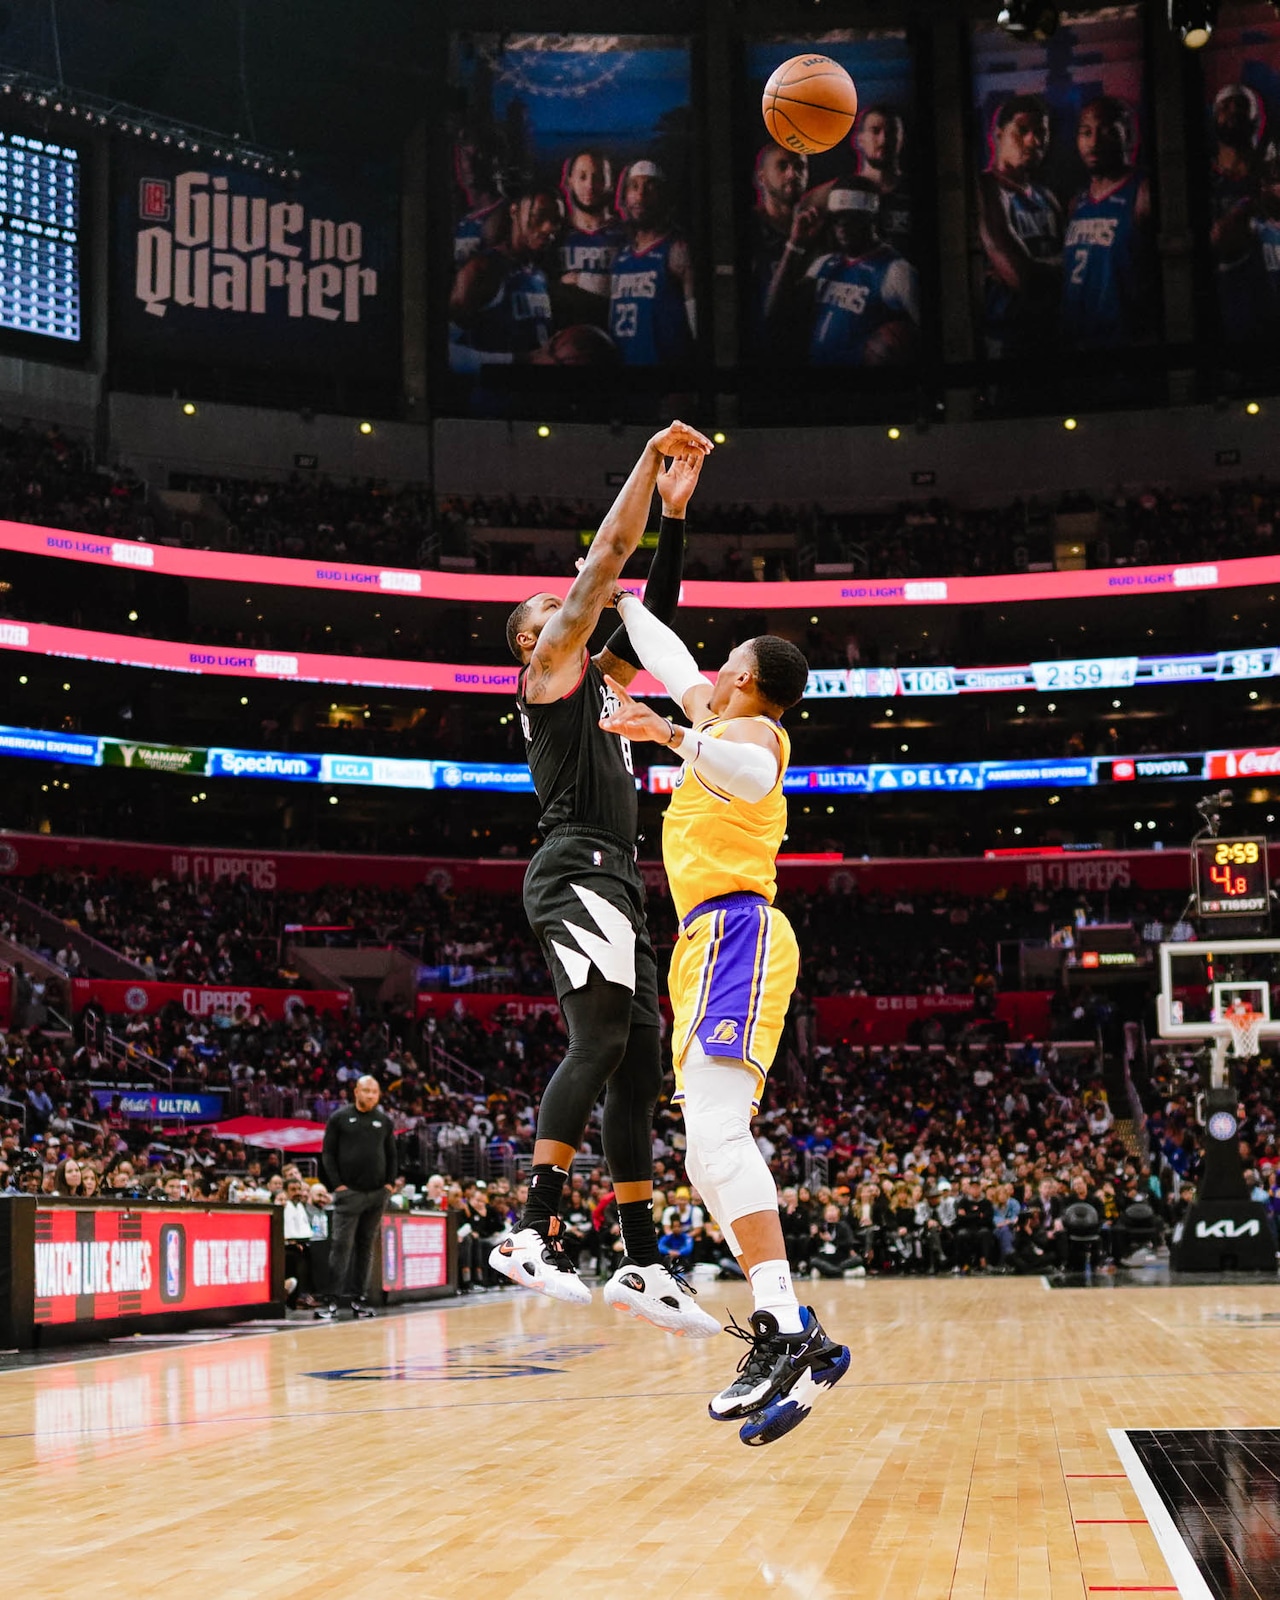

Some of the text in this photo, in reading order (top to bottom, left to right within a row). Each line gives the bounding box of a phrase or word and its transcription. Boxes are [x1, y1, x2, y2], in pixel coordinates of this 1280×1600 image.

[175, 171, 362, 262] Give no
[136, 226, 377, 323] Quarter
[1071, 249, 1088, 284] 2
[615, 303, 638, 337] 23
[47, 537, 73, 550] BUD
[76, 541, 111, 555] LIGHT
[316, 570, 342, 580] BUD
[344, 572, 380, 584] LIGHT
[1108, 576, 1135, 586] BUD
[1137, 571, 1174, 585] LIGHT
[841, 588, 867, 597] BUD
[869, 586, 904, 597] LIGHT
[190, 653, 216, 665] BUD
[218, 656, 254, 668] LIGHT
[455, 673, 517, 685] BUD LIGHT
[905, 654, 1265, 692] 106 Clippers 2:59 4 Lakers 95
[0, 736, 93, 756] MERICAN EXPRESS
[221, 753, 309, 776] Spectrum
[335, 764, 370, 777] UCLA
[1136, 760, 1189, 775] TOYOTA
[462, 770, 531, 784] crypto.com
[818, 772, 866, 786] ULTRA
[902, 768, 975, 786] DELTA
[987, 768, 1040, 780] AMERICAN
[1215, 842, 1259, 865] 2:59
[1209, 866, 1248, 896] 4.8
[1221, 898, 1266, 911] TISSOT
[1099, 953, 1135, 965] TOYOTA
[183, 988, 252, 1017] CLIPPERS
[159, 1099, 201, 1114] ULTRA
[35, 1240, 152, 1297] WATCH LIVE GAMES
